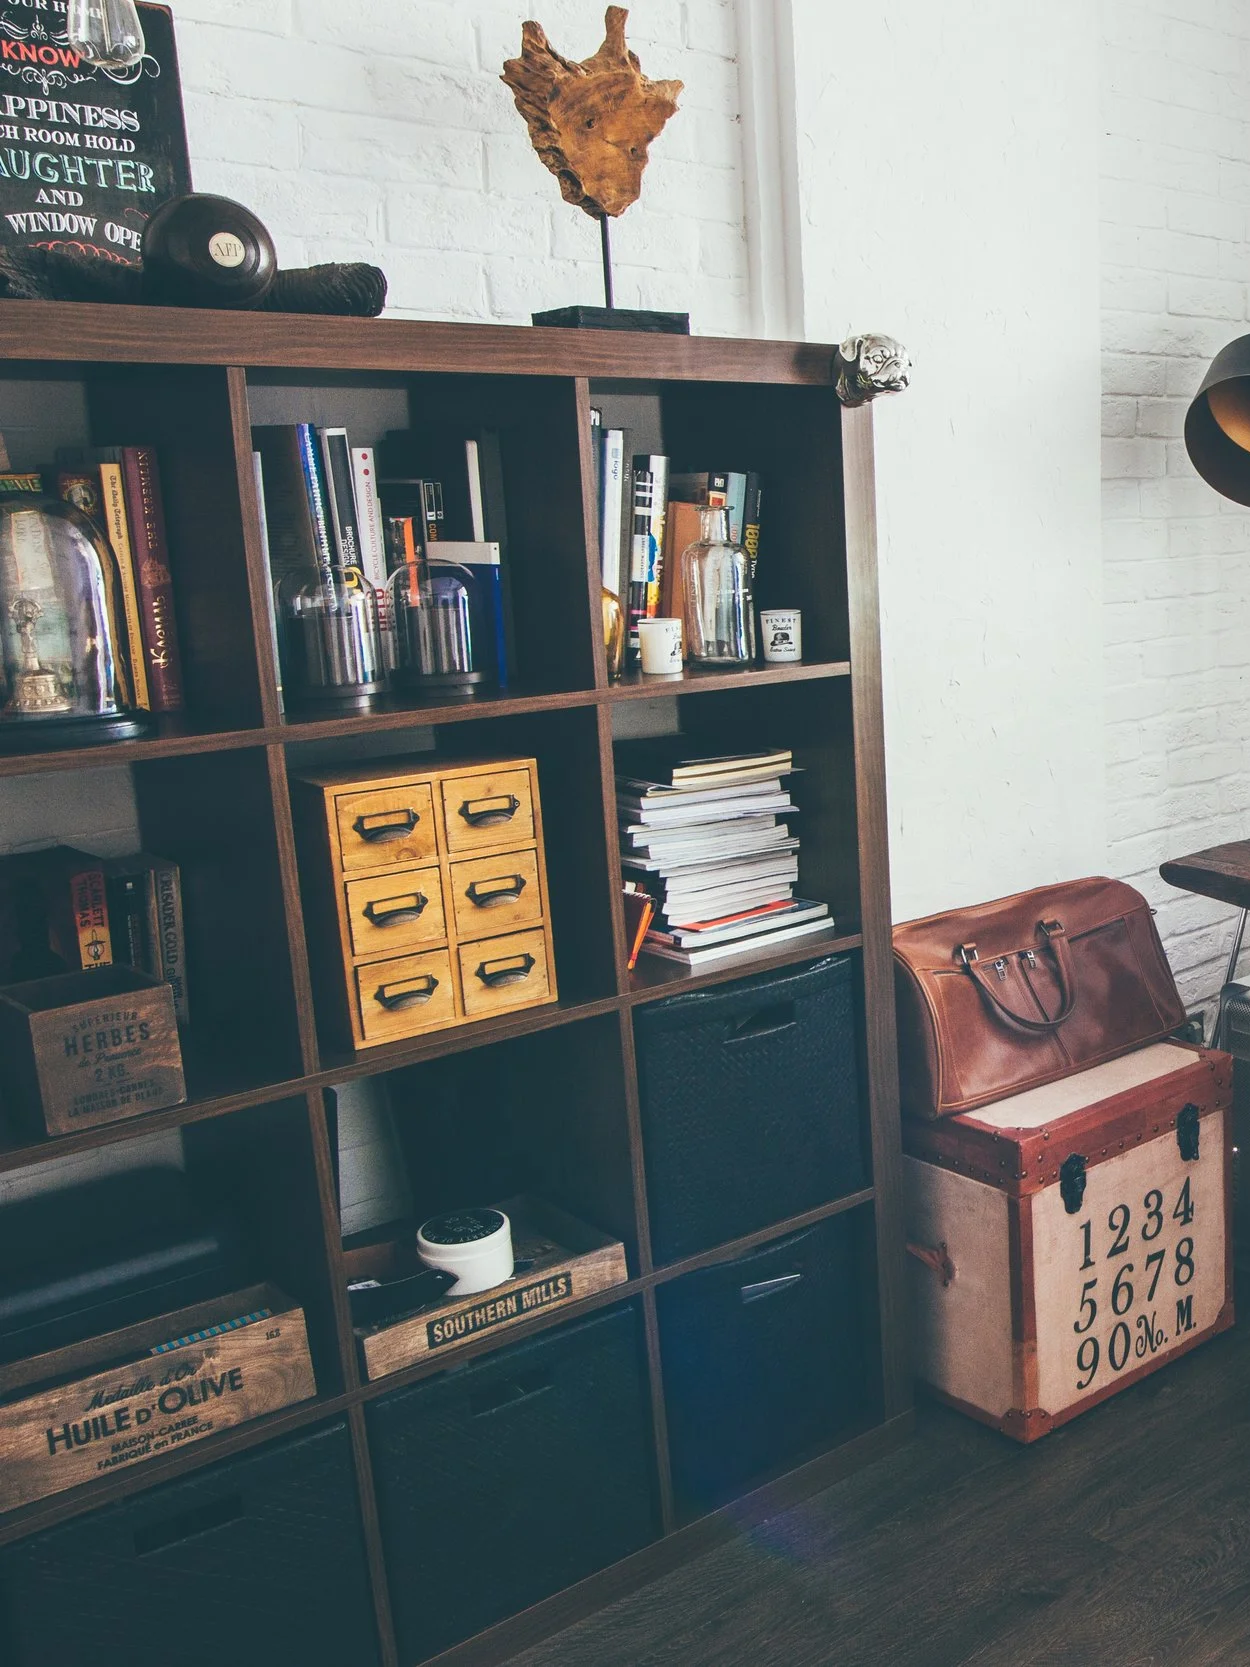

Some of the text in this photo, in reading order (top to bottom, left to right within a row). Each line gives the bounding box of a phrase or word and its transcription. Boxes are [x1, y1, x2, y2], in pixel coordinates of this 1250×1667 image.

[1, 39, 86, 69] KNOW
[0, 95, 140, 132] PPINESS
[24, 128, 81, 148] ROOM
[84, 133, 136, 153] HOLD
[35, 188, 84, 208] AND
[4, 211, 97, 237] WINDOW
[137, 451, 151, 514] KREMLIN
[345, 525, 357, 565] BROCHURE
[364, 481, 380, 580] BICYCLE CULTURE AND DESIGN
[765, 617, 797, 625] FINEST
[63, 1021, 151, 1057] HERBES
[432, 1277, 567, 1342] SOUTHERN MILLS
[45, 1406, 132, 1455] HUILE
[170, 1421, 214, 1444] FRANCE
